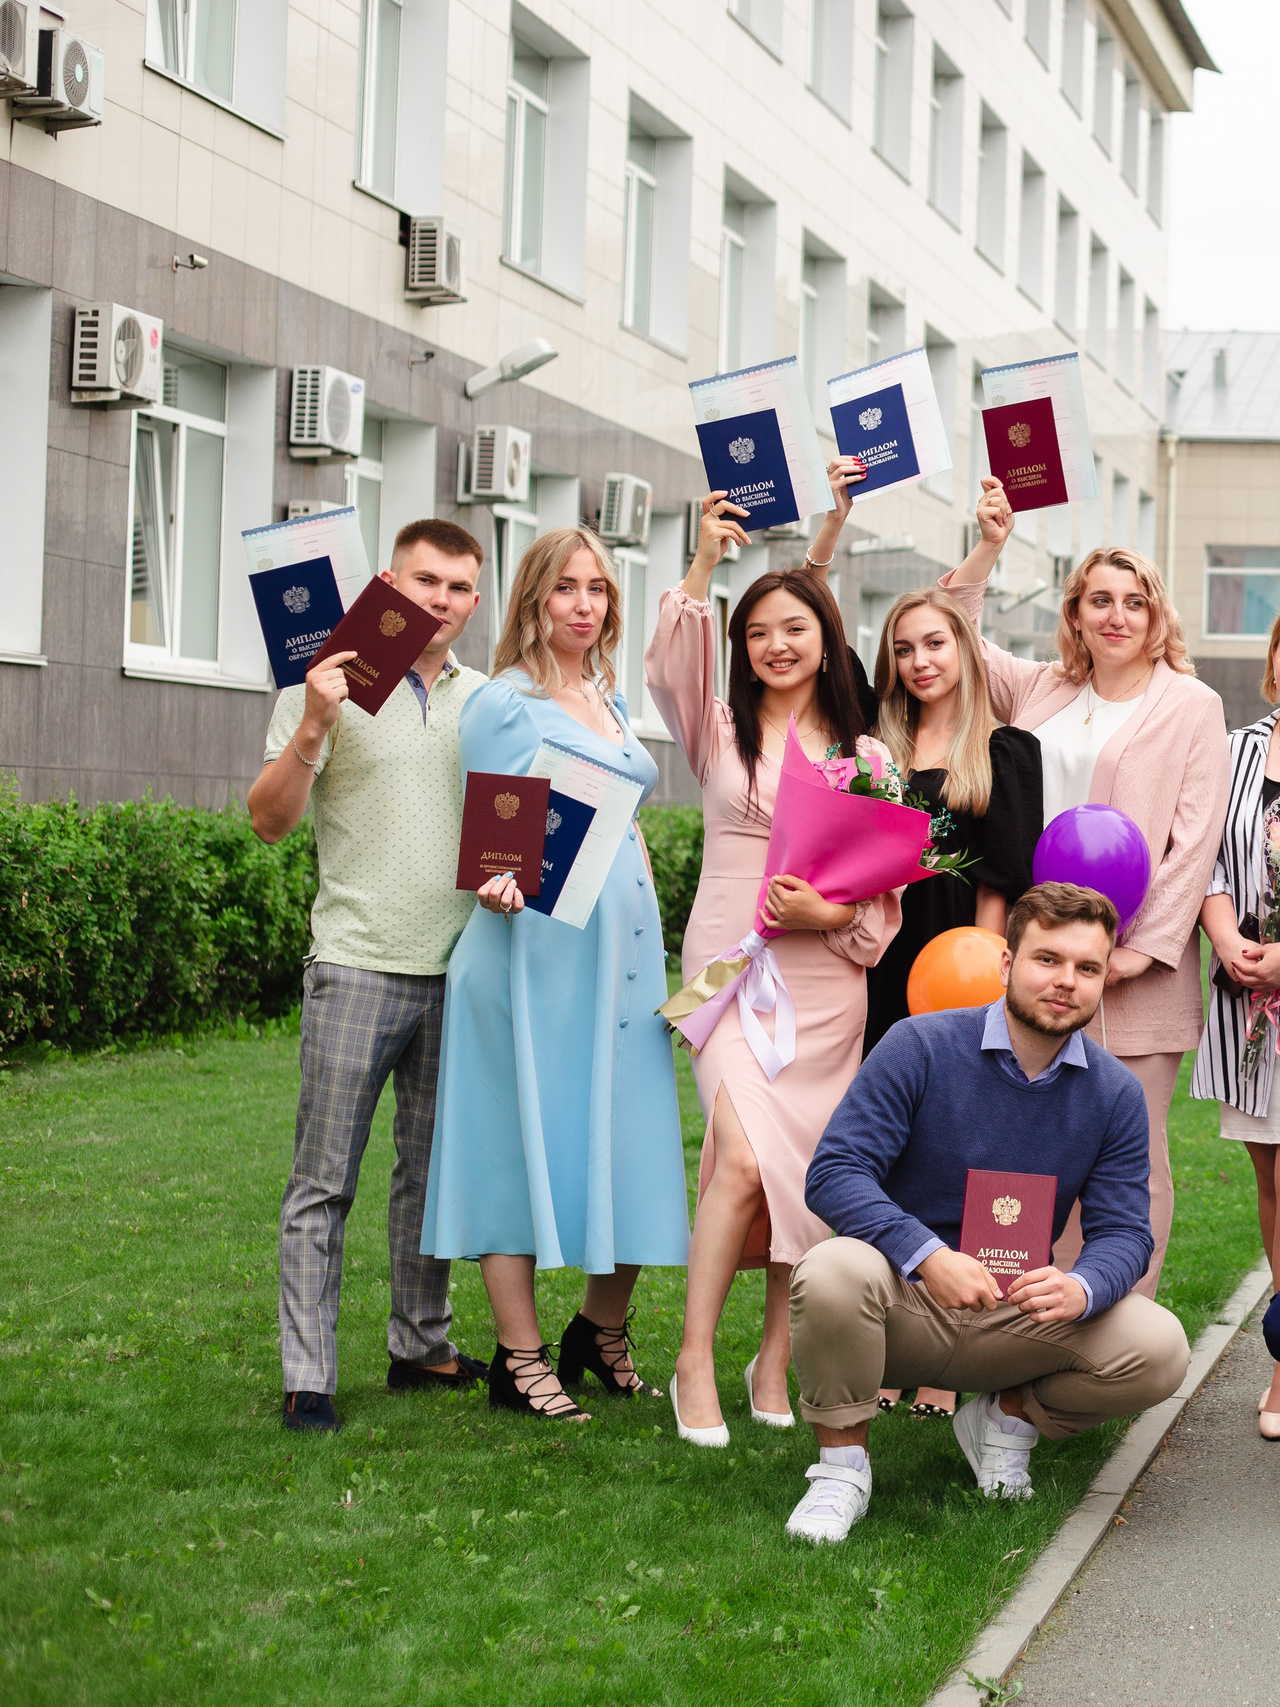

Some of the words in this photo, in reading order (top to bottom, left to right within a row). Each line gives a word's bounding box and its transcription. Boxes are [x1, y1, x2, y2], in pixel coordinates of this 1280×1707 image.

[858, 439, 898, 459] ДИПЛОМ
[867, 453, 898, 467] АЗОВАНИИ
[1006, 463, 1047, 479] ДИПЛОМ
[730, 480, 775, 498] ДИПЛОМ
[285, 628, 331, 649] ДИПЛОМ
[481, 852, 522, 862] ДИПЛОМ
[977, 1247, 1028, 1260] ДИПЛОМ
[984, 1267, 1025, 1275] РАЗОВАНИИ
[989, 1260, 1020, 1268] ВЫСШЕМ
